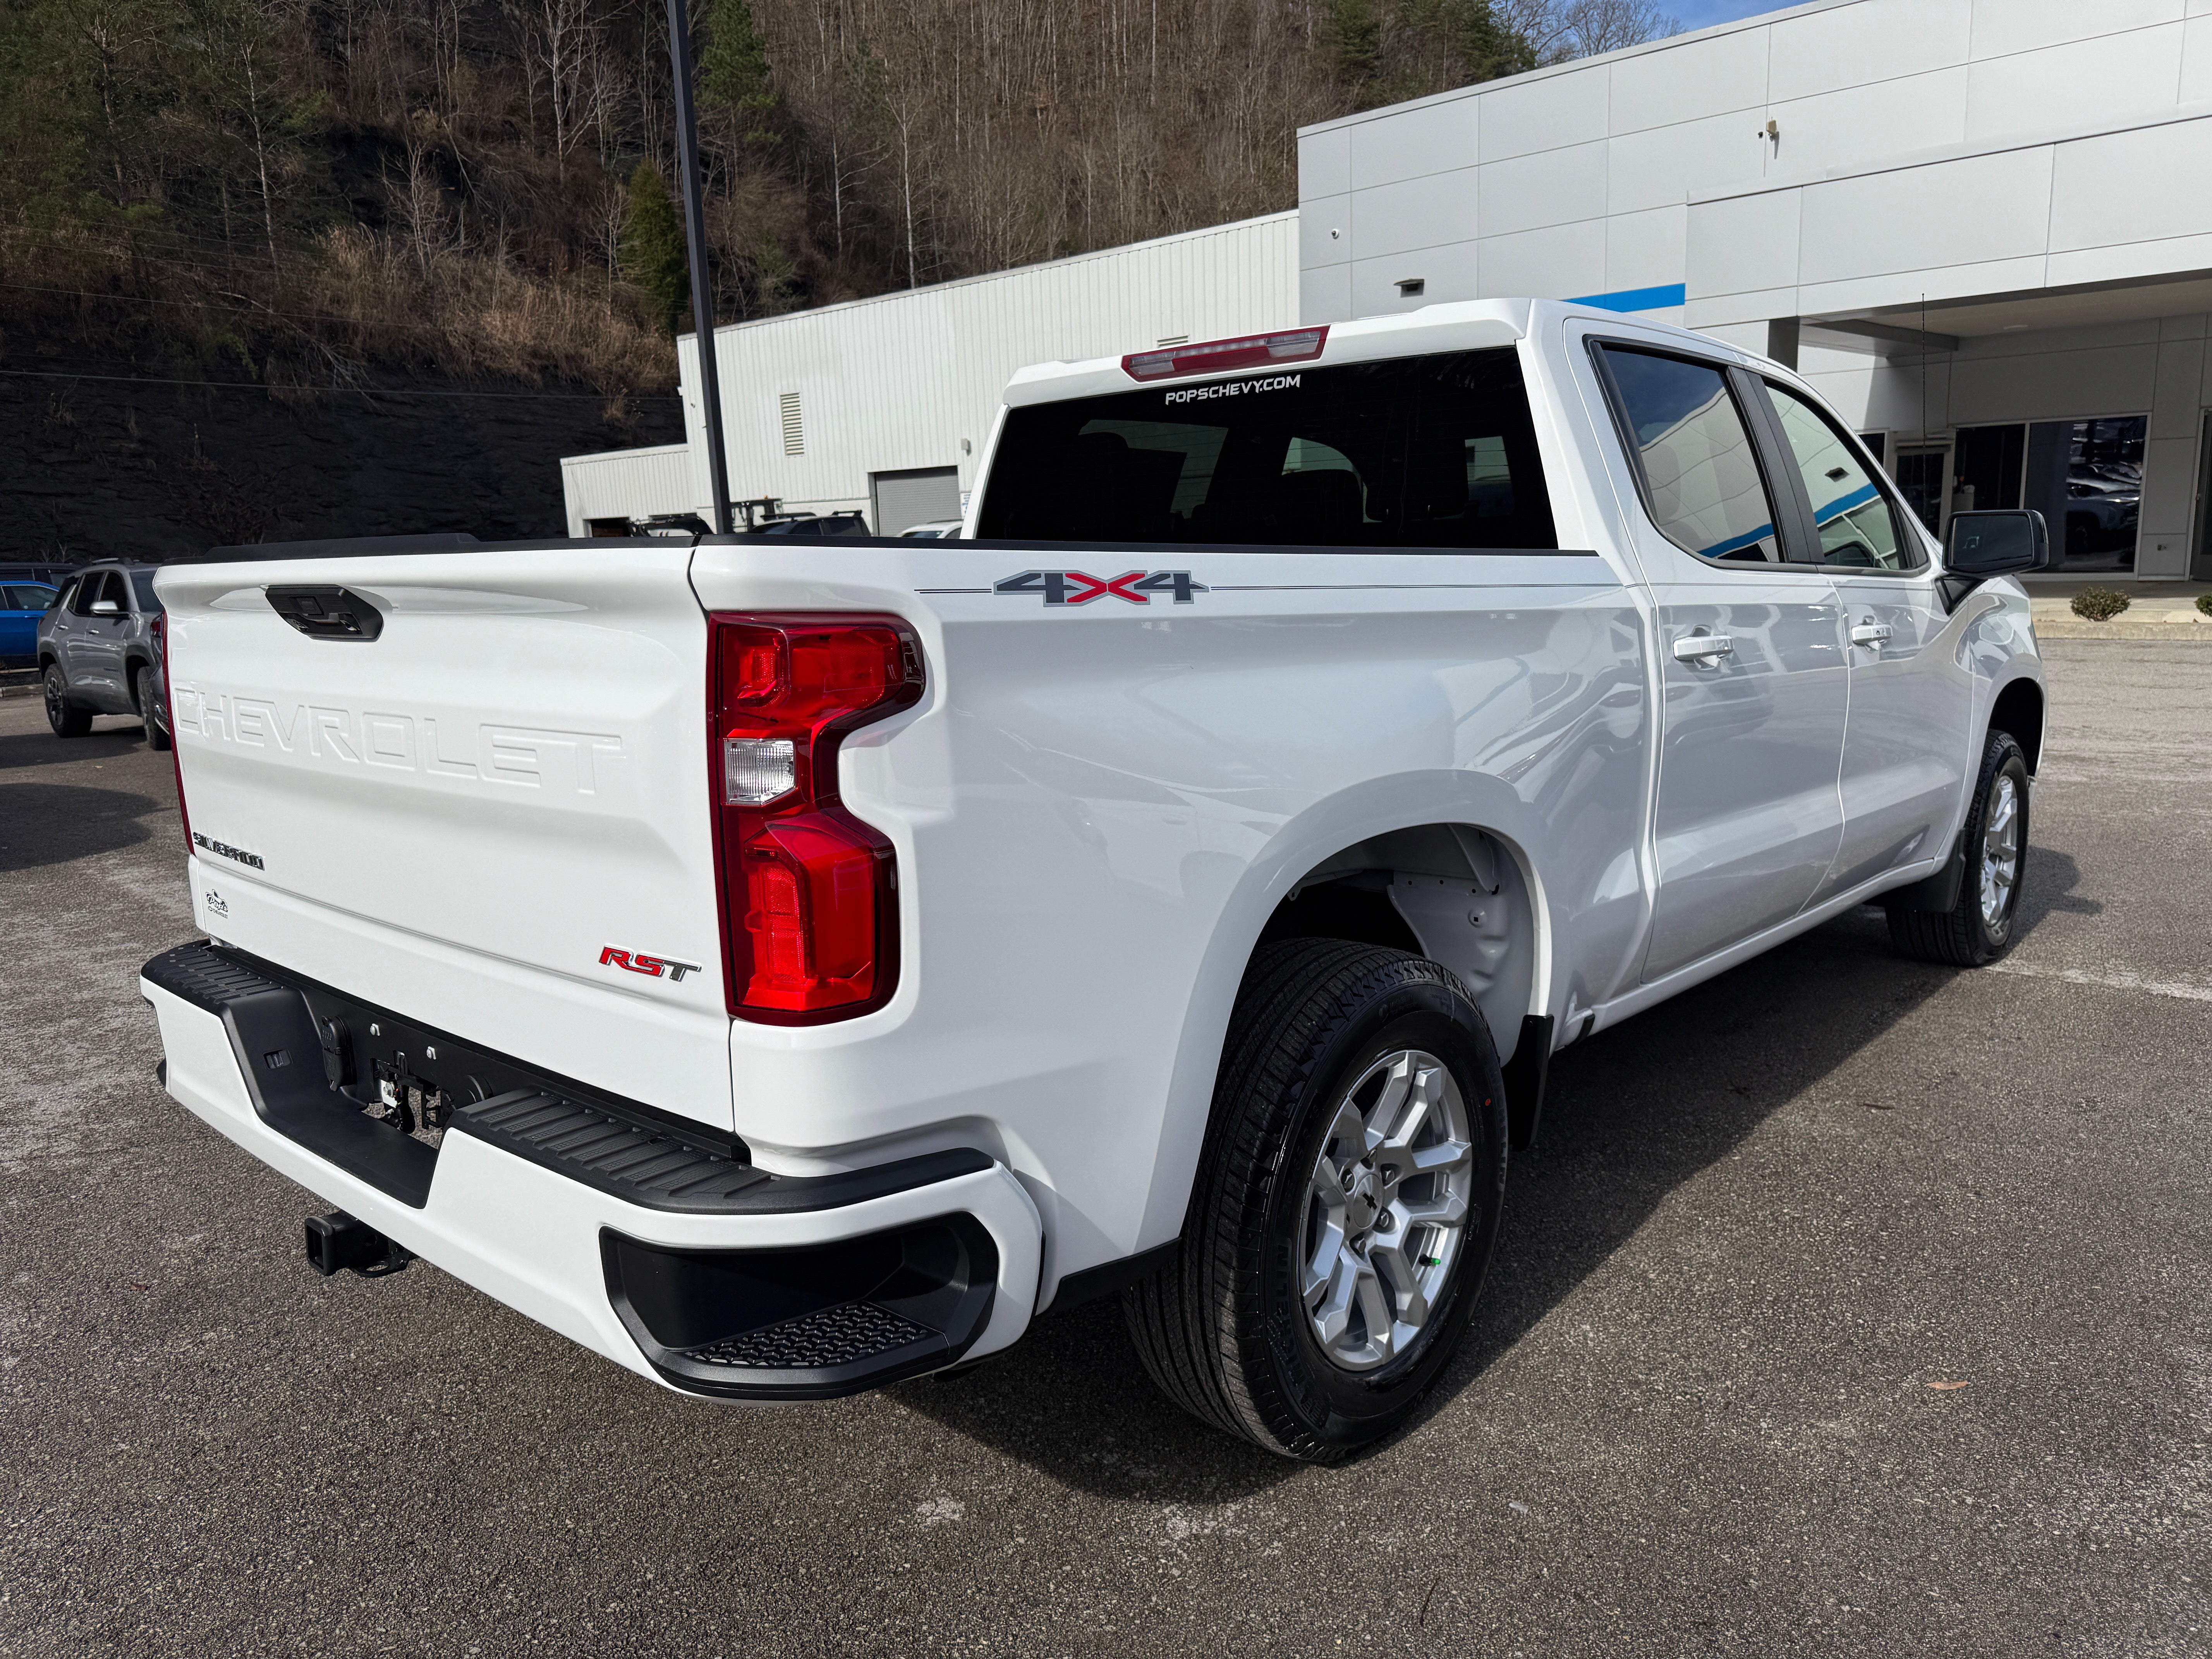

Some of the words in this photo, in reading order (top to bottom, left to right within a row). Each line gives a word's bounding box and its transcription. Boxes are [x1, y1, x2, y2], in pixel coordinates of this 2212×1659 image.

[1165, 374, 1301, 405] POPSCHEVY.COM
[173, 687, 622, 795] CHEVROLET
[599, 943, 702, 982] RST
